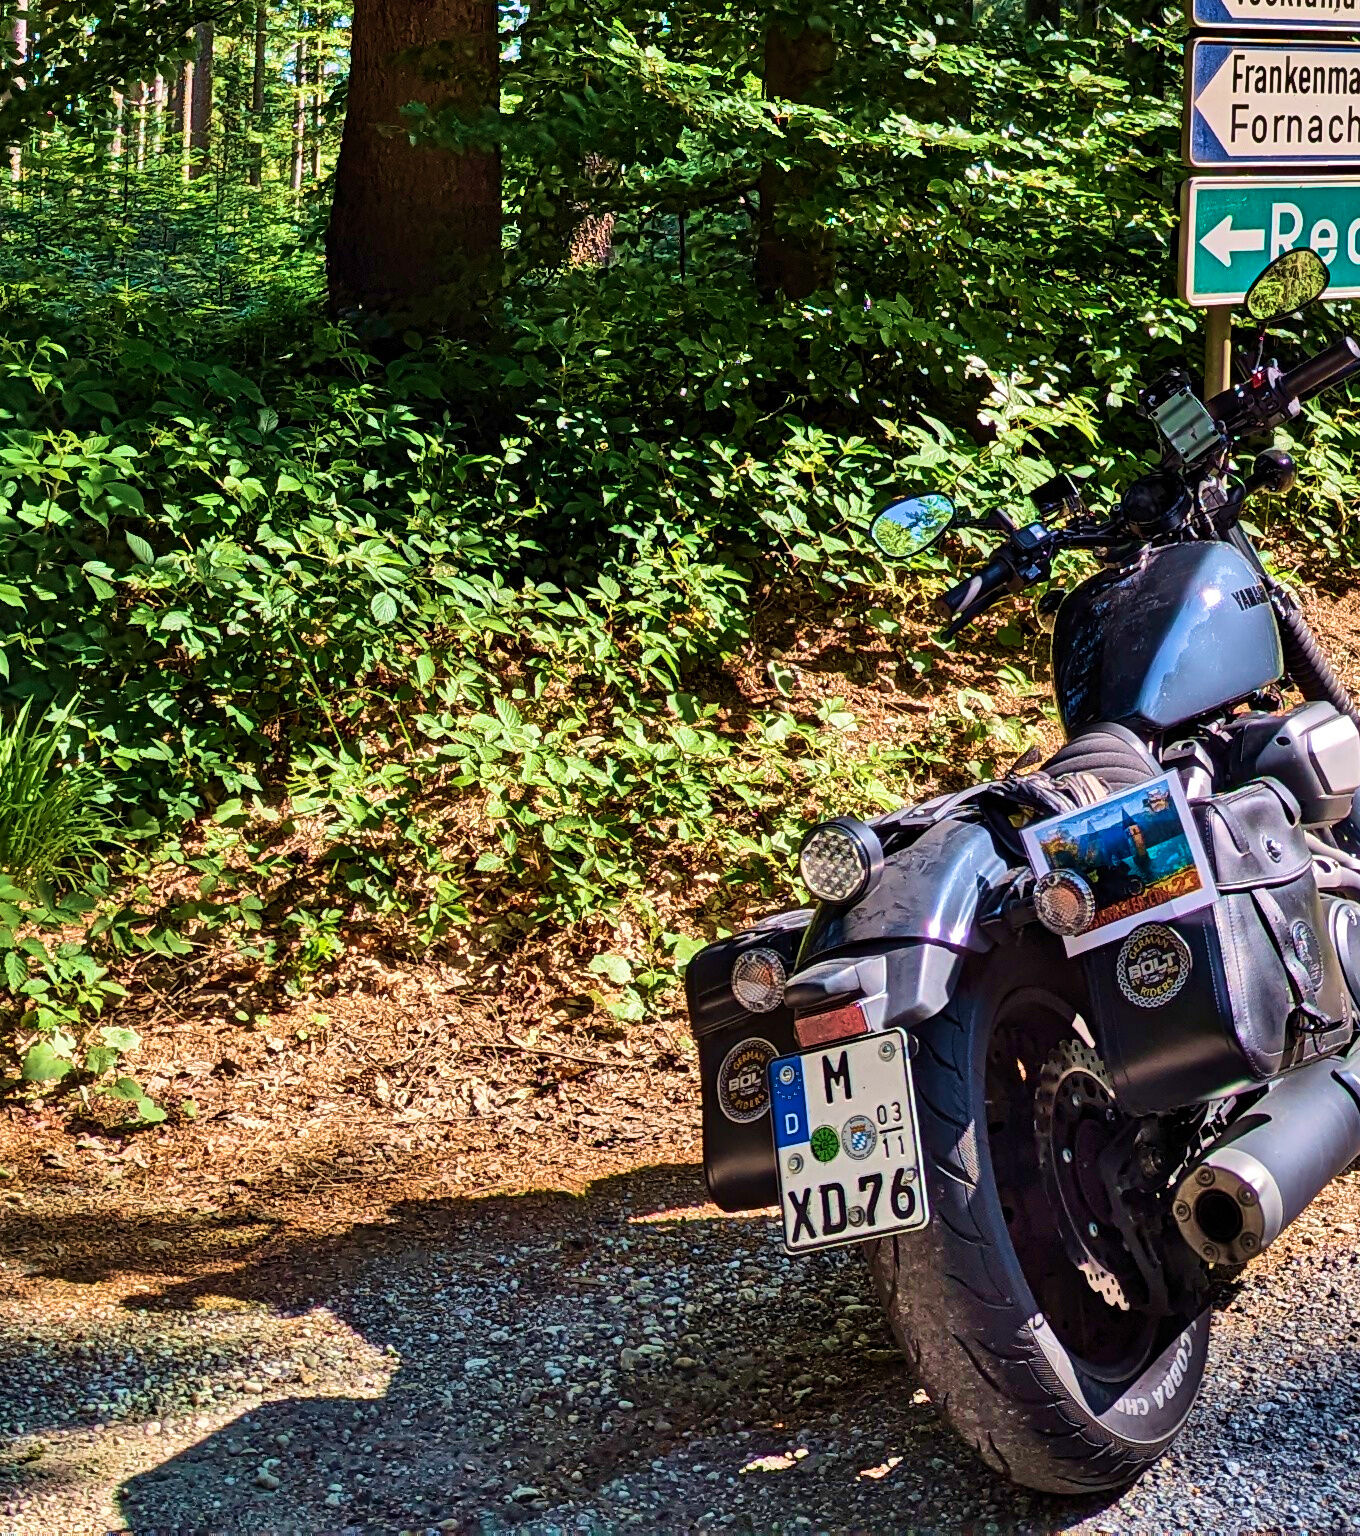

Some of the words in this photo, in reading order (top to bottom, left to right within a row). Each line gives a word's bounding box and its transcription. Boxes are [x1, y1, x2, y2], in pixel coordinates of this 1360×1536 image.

[1128, 935, 1169, 960] GERMAN
[1127, 951, 1176, 980] BOLT
[1140, 976, 1174, 997] RIDERS
[733, 1050, 766, 1070] GERMAN
[728, 1069, 765, 1092] BOL
[821, 1050, 853, 1104] M
[784, 1113, 799, 1135] D
[1151, 1331, 1193, 1410] COBRA
